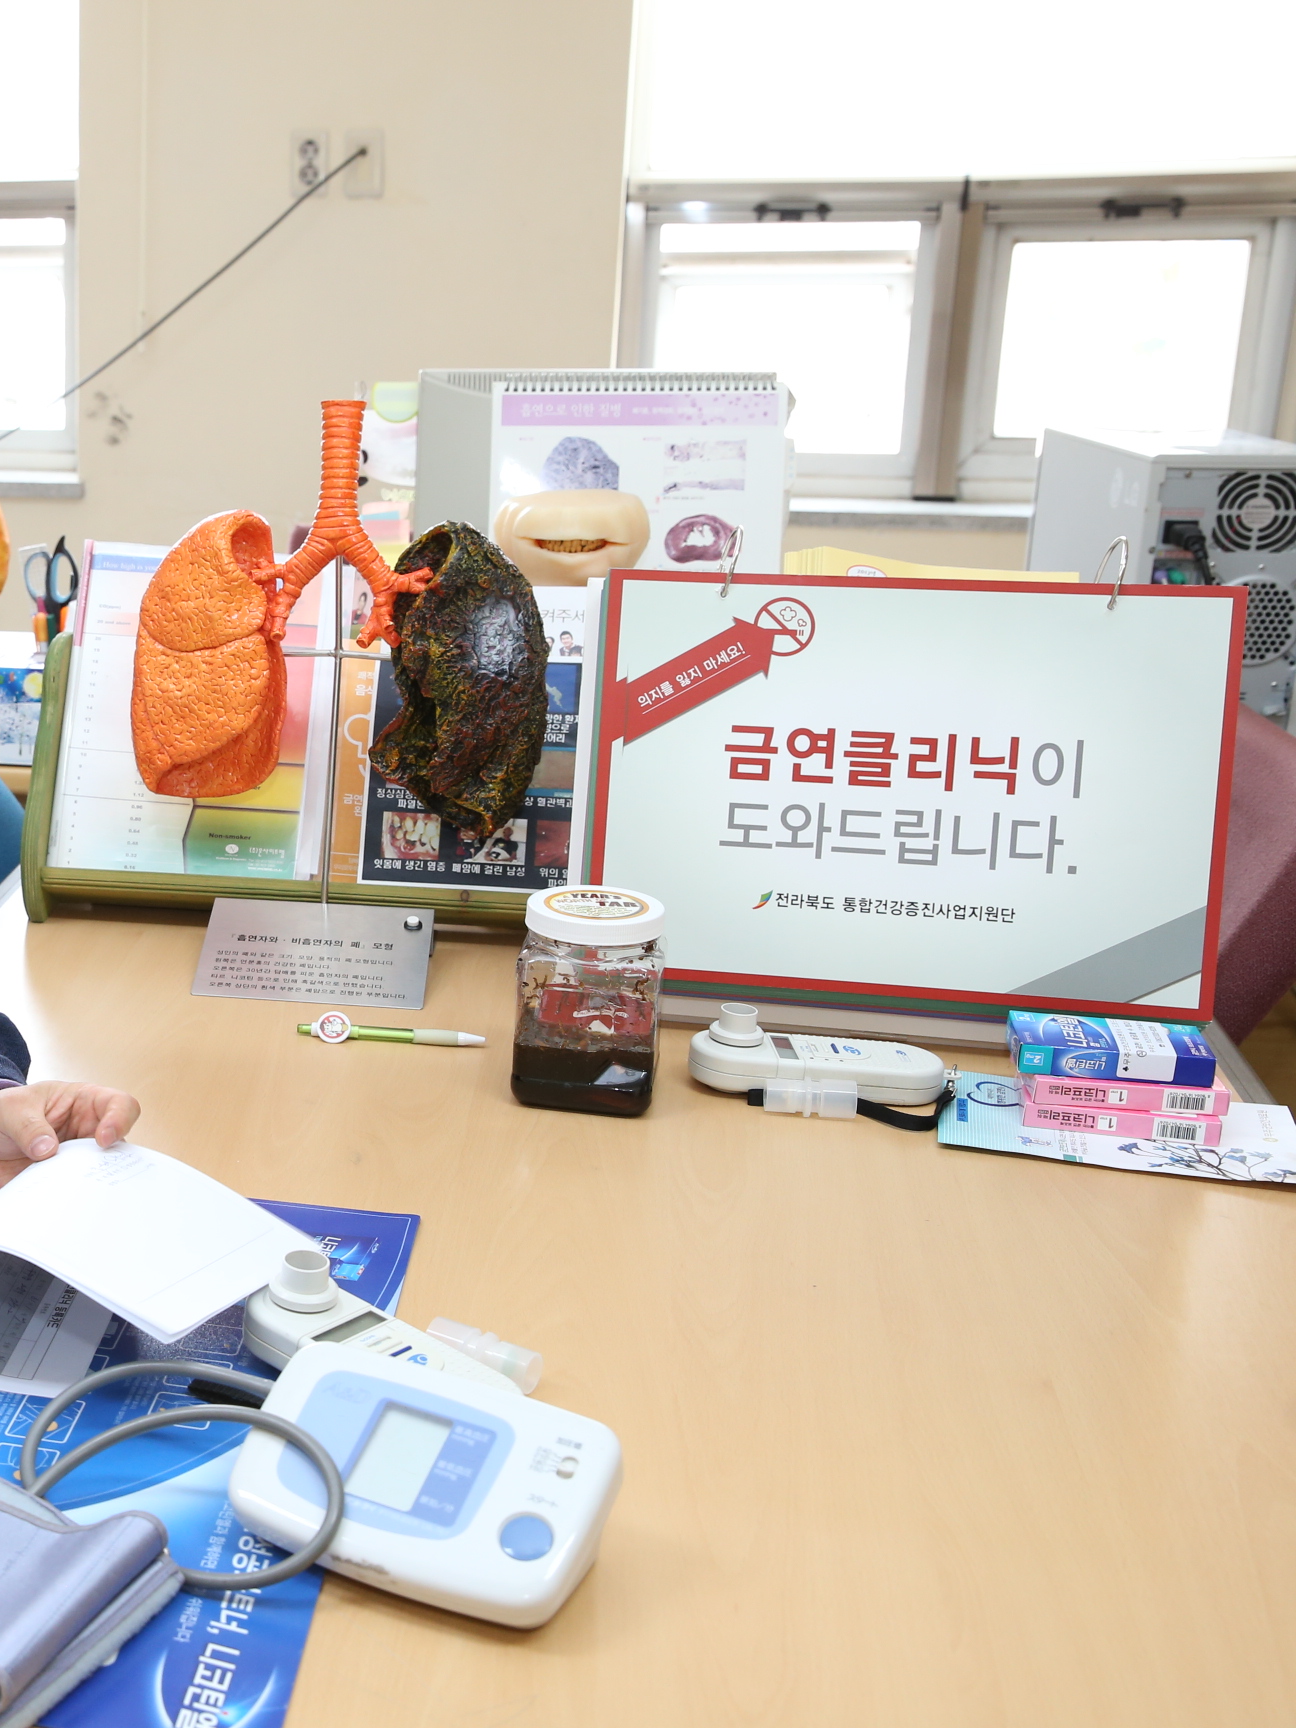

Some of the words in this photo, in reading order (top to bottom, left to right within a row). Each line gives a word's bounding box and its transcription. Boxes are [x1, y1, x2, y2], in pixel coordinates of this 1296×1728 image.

[520, 403, 567, 417] 흡연으로
[571, 403, 594, 417] 인한
[598, 403, 622, 417] 질병
[637, 681, 674, 710] 의지를
[675, 665, 702, 690] 잃지
[703, 642, 746, 674] 마세요!
[723, 724, 1086, 799] 금연클리닉이
[719, 801, 1078, 876] 도와드립니다.
[374, 859, 402, 869] 잇몸에
[405, 861, 424, 870] 생긴
[427, 862, 445, 872] 염증
[452, 863, 480, 874] 폐암에
[484, 864, 502, 875] 걸린
[506, 866, 525, 877] 남성
[540, 868, 559, 878] 위의
[596, 899, 638, 908] TAR
[775, 890, 835, 912] 전라북도
[842, 896, 1016, 925] 통합건강증진사업지원단
[292, 937, 343, 948] 비흡연자의
[372, 941, 394, 950] 모형
[302, 979, 340, 987] 흑갈색으로
[305, 987, 336, 995] 폐암으로
[1054, 1016, 1087, 1046] 니코틴엘
[1064, 1058, 1106, 1069] 니코틴엘
[1059, 1086, 1106, 1098] 니코프리
[1117, 1090, 1124, 1102] 1
[1048, 1110, 1095, 1124] 니코프리
[1107, 1117, 1113, 1128] 1
[45, 1305, 65, 1329] 등록카드
[174, 1642, 240, 1728] 니코틴엘
